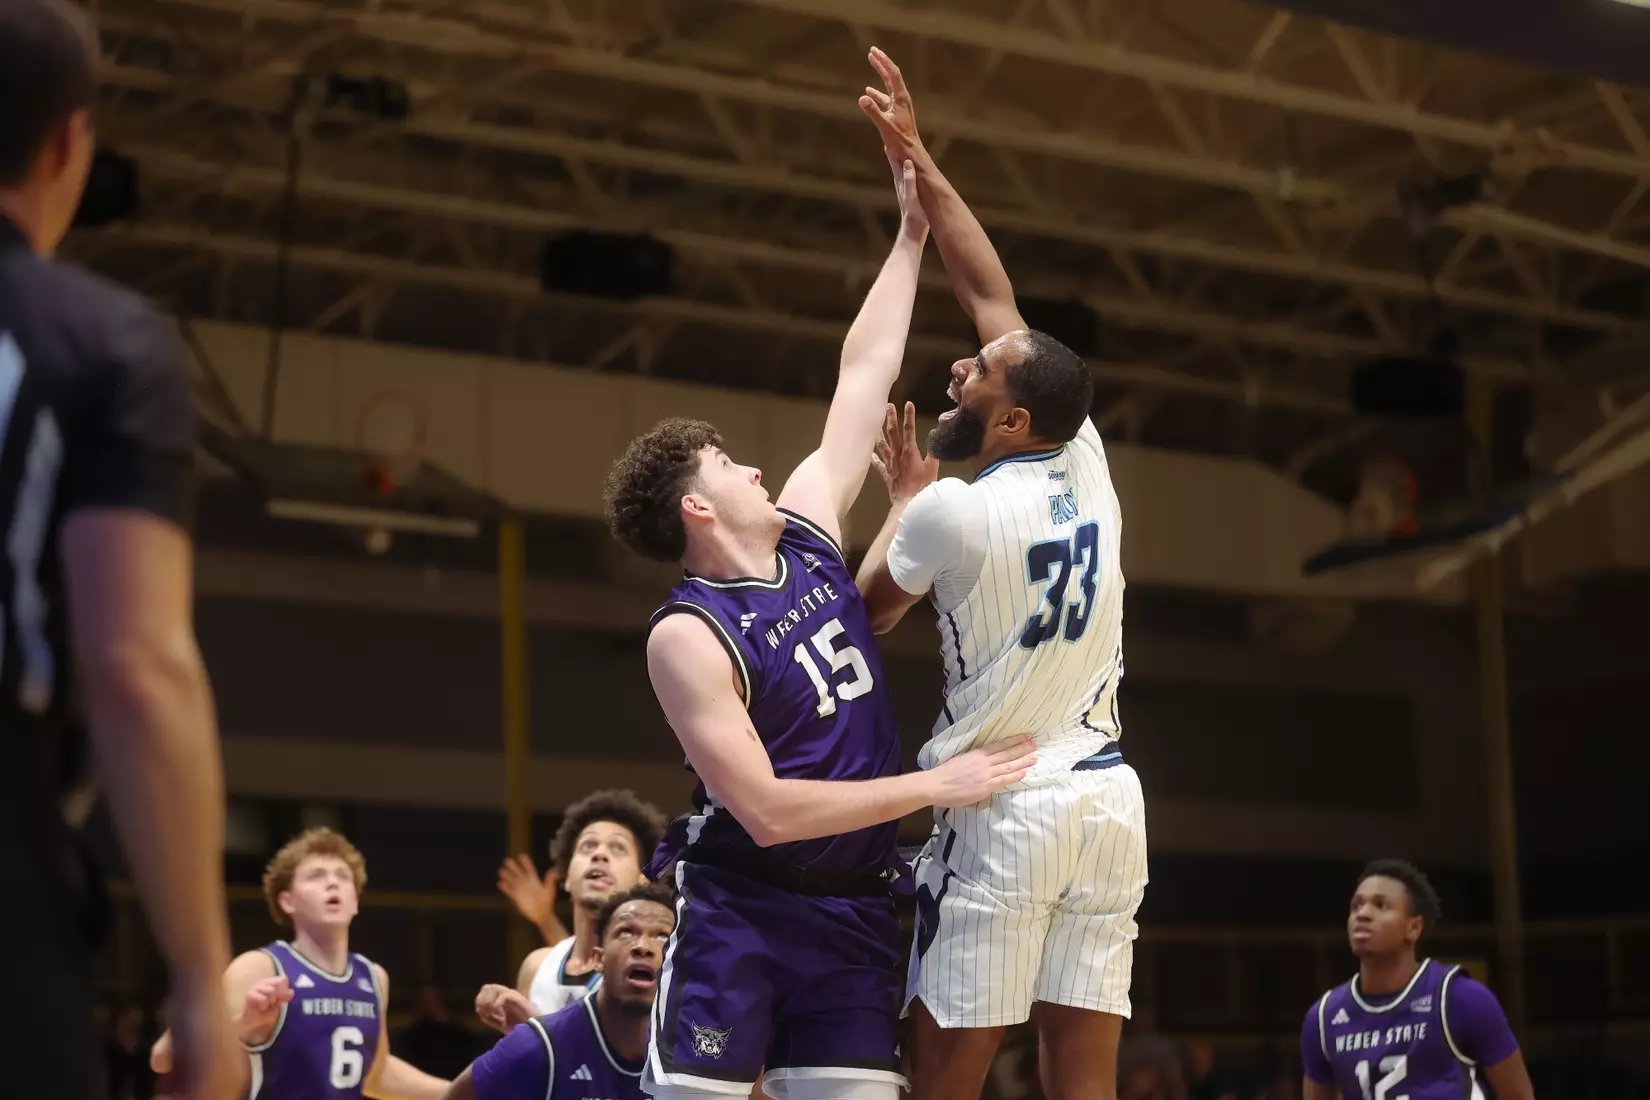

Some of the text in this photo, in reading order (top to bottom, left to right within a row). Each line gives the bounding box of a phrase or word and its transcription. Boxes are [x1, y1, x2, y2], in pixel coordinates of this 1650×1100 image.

[1018, 520, 1099, 650] 33
[794, 618, 873, 718] 15
[302, 998, 343, 1015] WEBER
[330, 1026, 364, 1089] 6
[1336, 1022, 1427, 1053] WEBER STATE
[1355, 1054, 1409, 1100] 12
